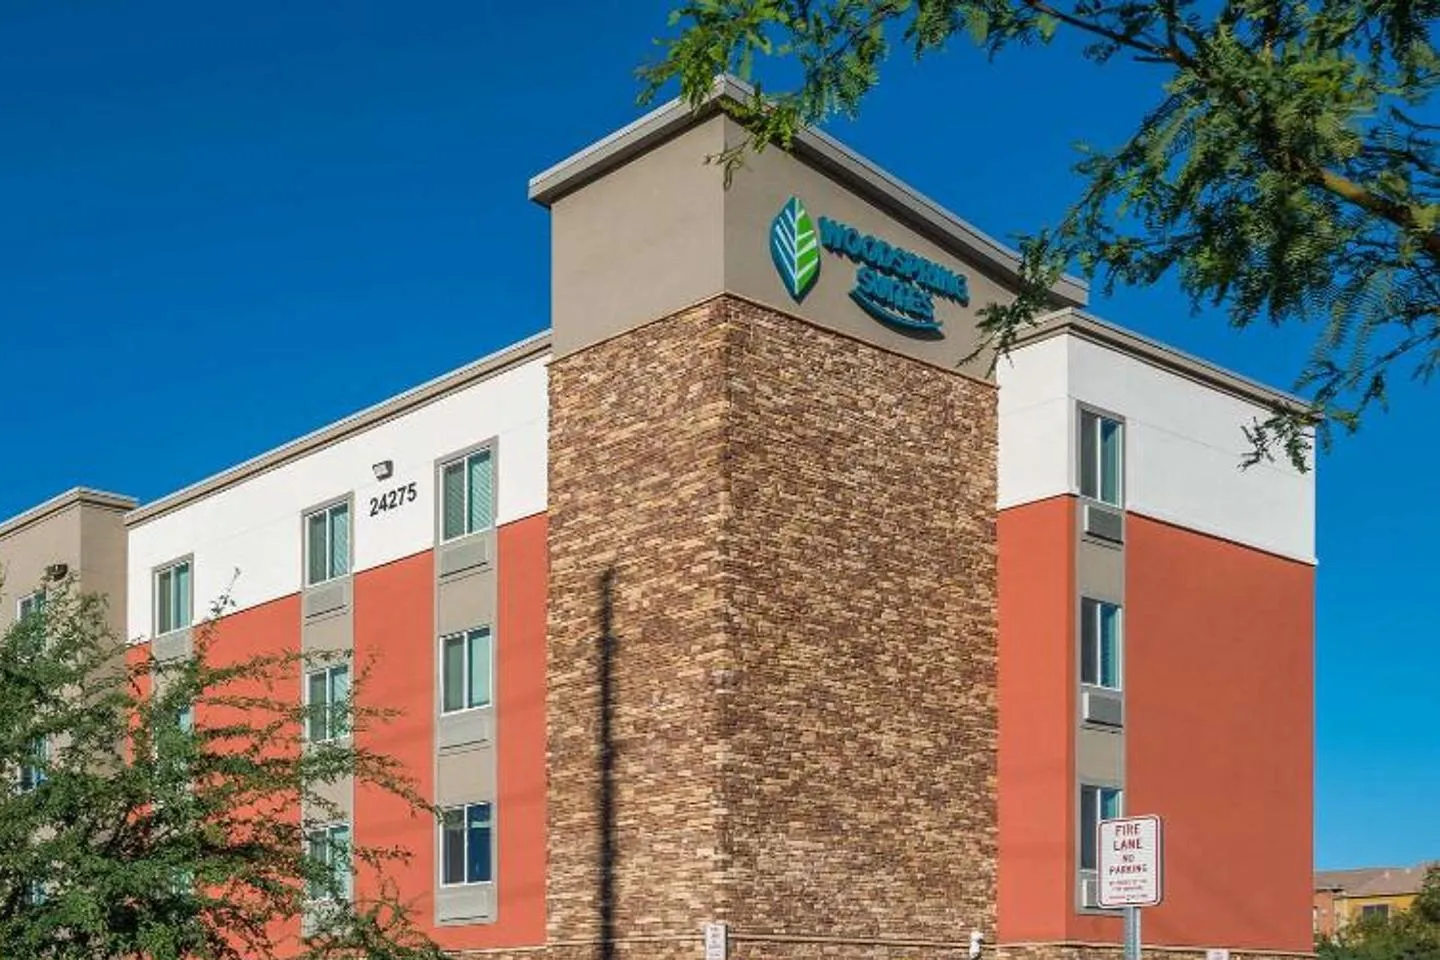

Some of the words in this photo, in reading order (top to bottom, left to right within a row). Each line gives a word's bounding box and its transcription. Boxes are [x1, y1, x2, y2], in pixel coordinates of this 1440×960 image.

[818, 216, 969, 306] WOODSPRING
[369, 481, 418, 517] 24275
[1115, 823, 1140, 836] FIRE
[1113, 839, 1143, 851] LANE
[1123, 854, 1135, 862] NO
